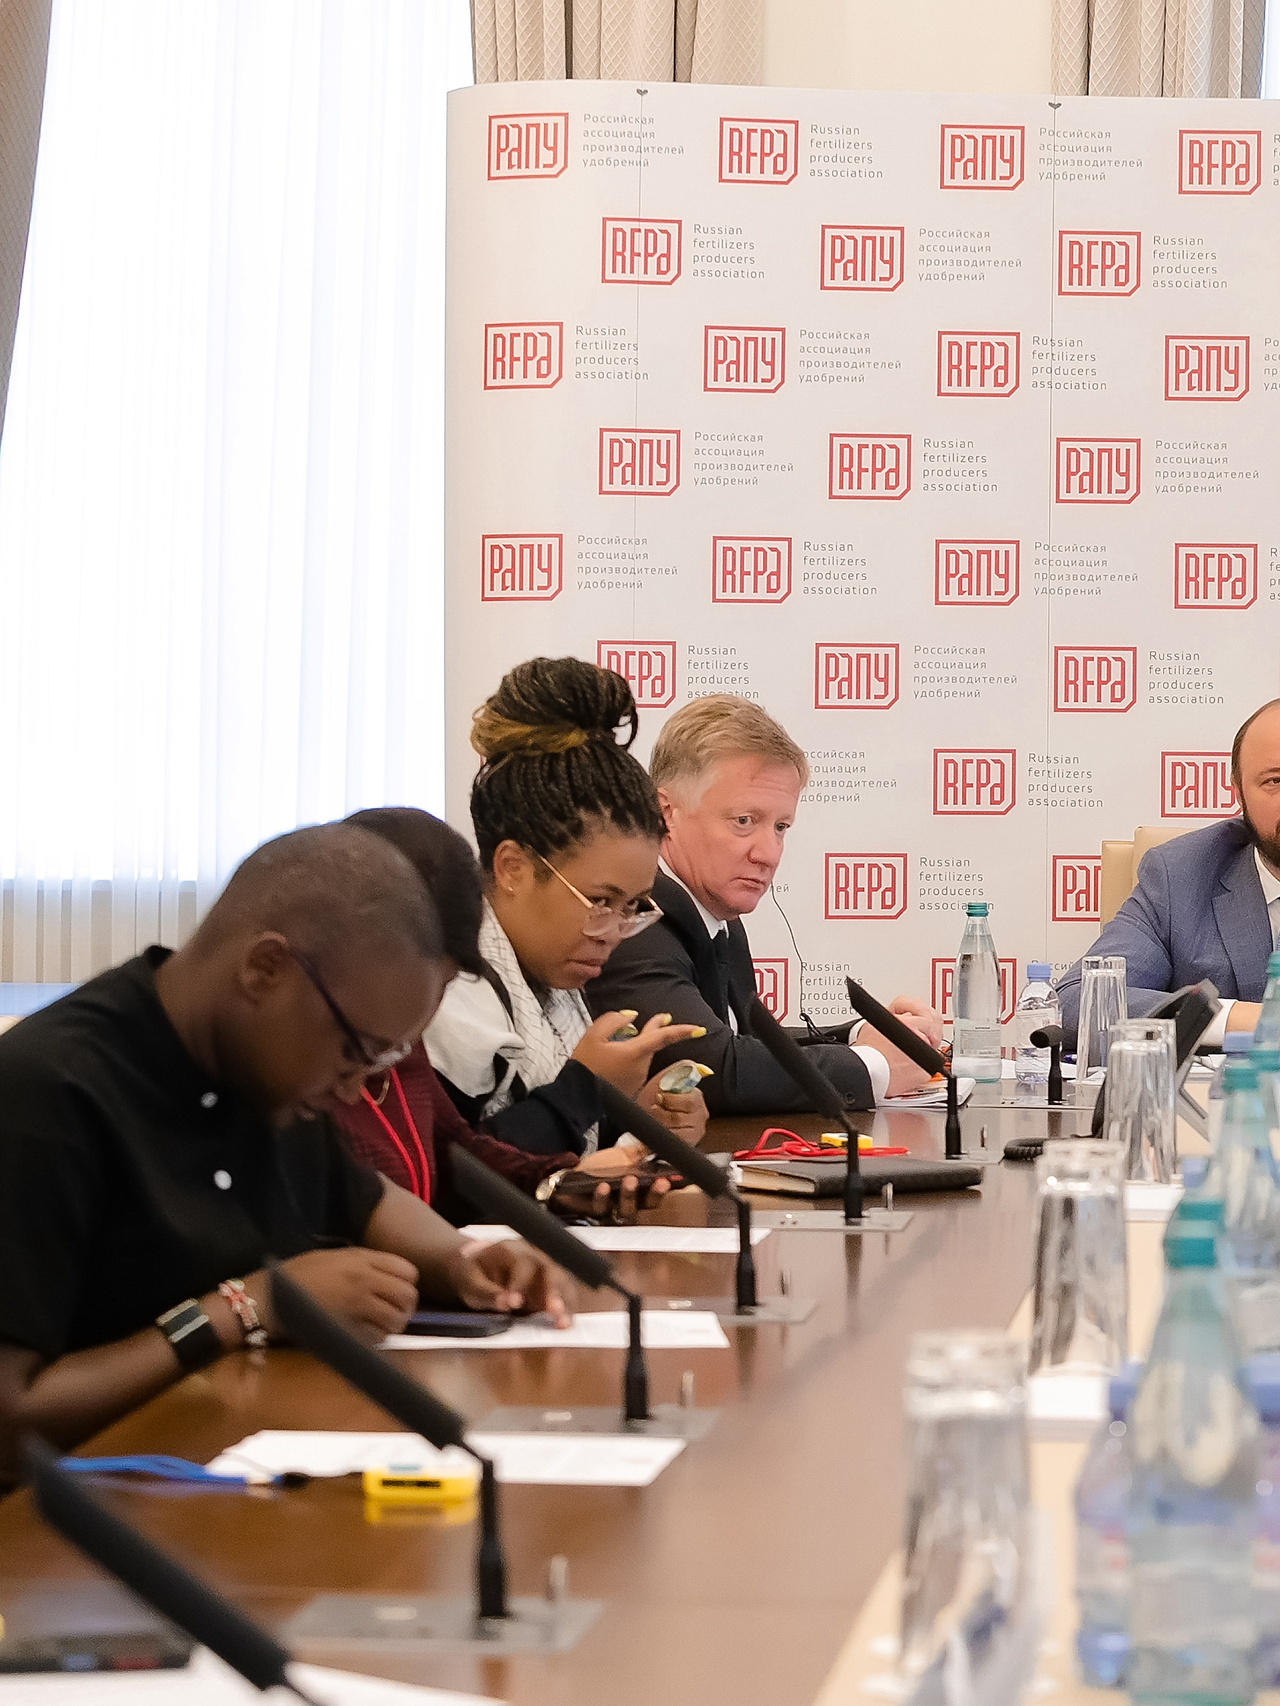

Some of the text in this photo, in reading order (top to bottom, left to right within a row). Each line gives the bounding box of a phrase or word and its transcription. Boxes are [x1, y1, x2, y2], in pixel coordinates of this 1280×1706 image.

[810, 123, 860, 136] Russian
[810, 138, 873, 151] fertilizers
[809, 152, 874, 165] producers
[809, 167, 883, 179] association
[693, 223, 743, 236] Russian
[919, 227, 991, 239] Российская
[692, 237, 755, 251] fertilizers
[1153, 235, 1204, 246] Russian
[918, 244, 992, 254] ассоциация
[1152, 249, 1217, 261] fertilizers
[692, 253, 756, 265] producers
[918, 258, 1022, 268] производителей
[692, 267, 765, 279] association
[1152, 263, 1218, 276] producers
[918, 270, 985, 283] удобрений
[1152, 278, 1228, 289] association
[799, 329, 870, 341] Российская
[799, 345, 871, 356] ассоциация
[798, 359, 902, 370] производителей
[798, 372, 865, 385] удобрений
[694, 431, 764, 443] Российская
[923, 437, 974, 449] Russian
[1155, 439, 1228, 451] Российская
[693, 447, 765, 458] ассоциация
[922, 452, 987, 464] fertilizers
[1155, 456, 1229, 466] ассоциация
[693, 462, 794, 473] производителей
[922, 466, 988, 479] producers
[1154, 469, 1259, 480] производителей
[693, 475, 758, 487] удобрений
[922, 481, 998, 492] association
[1154, 482, 1223, 495] удобрений
[803, 540, 854, 552] Russian
[803, 555, 867, 567] fertilizers
[802, 570, 868, 582] producers
[802, 584, 878, 596] association
[687, 644, 737, 656] Russian
[914, 644, 986, 656] Российская
[1149, 650, 1200, 661] Russian
[687, 658, 749, 671] fertilizers
[913, 661, 987, 670] ассоциация
[1148, 664, 1213, 676] fertilizers
[687, 674, 750, 687] producers
[913, 674, 1018, 686] производителей
[1148, 679, 1214, 692] producers
[913, 688, 981, 700] удобрений
[1148, 693, 1224, 705] association
[919, 856, 971, 868] Russian
[919, 870, 984, 882] fertilizers
[919, 885, 984, 898] producers
[801, 961, 850, 972] Russian
